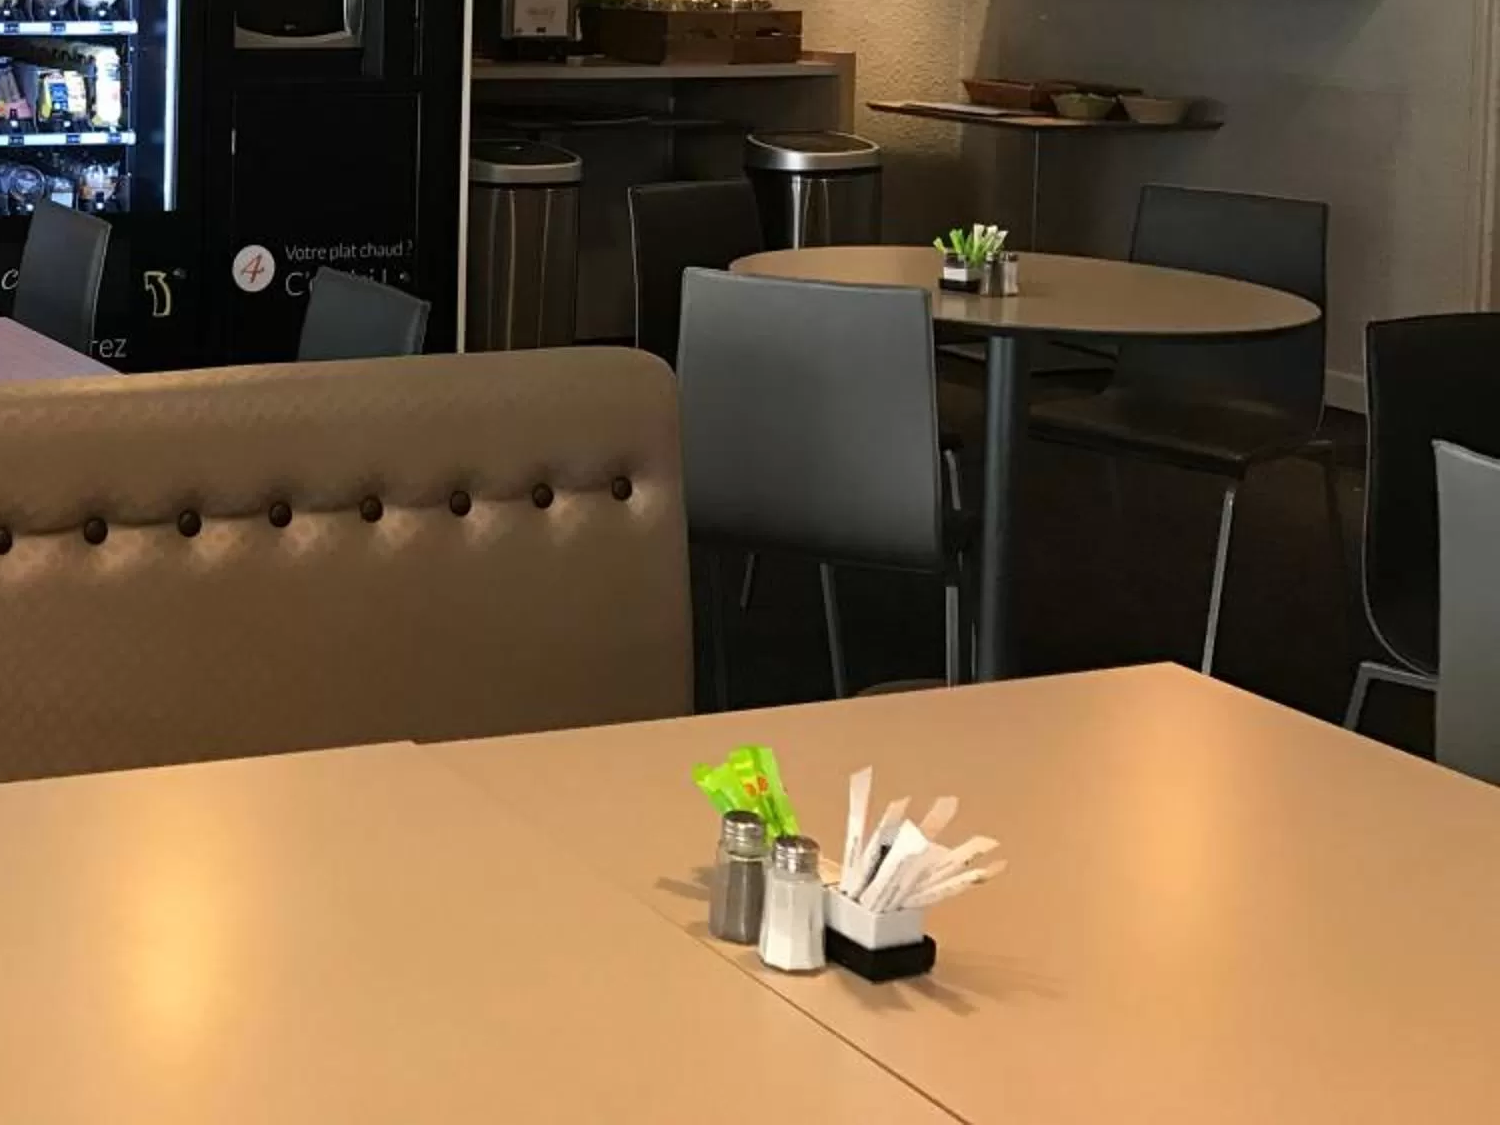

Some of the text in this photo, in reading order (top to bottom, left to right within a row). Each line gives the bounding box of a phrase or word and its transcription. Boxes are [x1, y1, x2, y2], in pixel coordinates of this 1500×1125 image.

[285, 244, 326, 261] Votre
[329, 242, 357, 262] plat
[360, 242, 403, 258] chaud
[240, 254, 265, 284] 4
